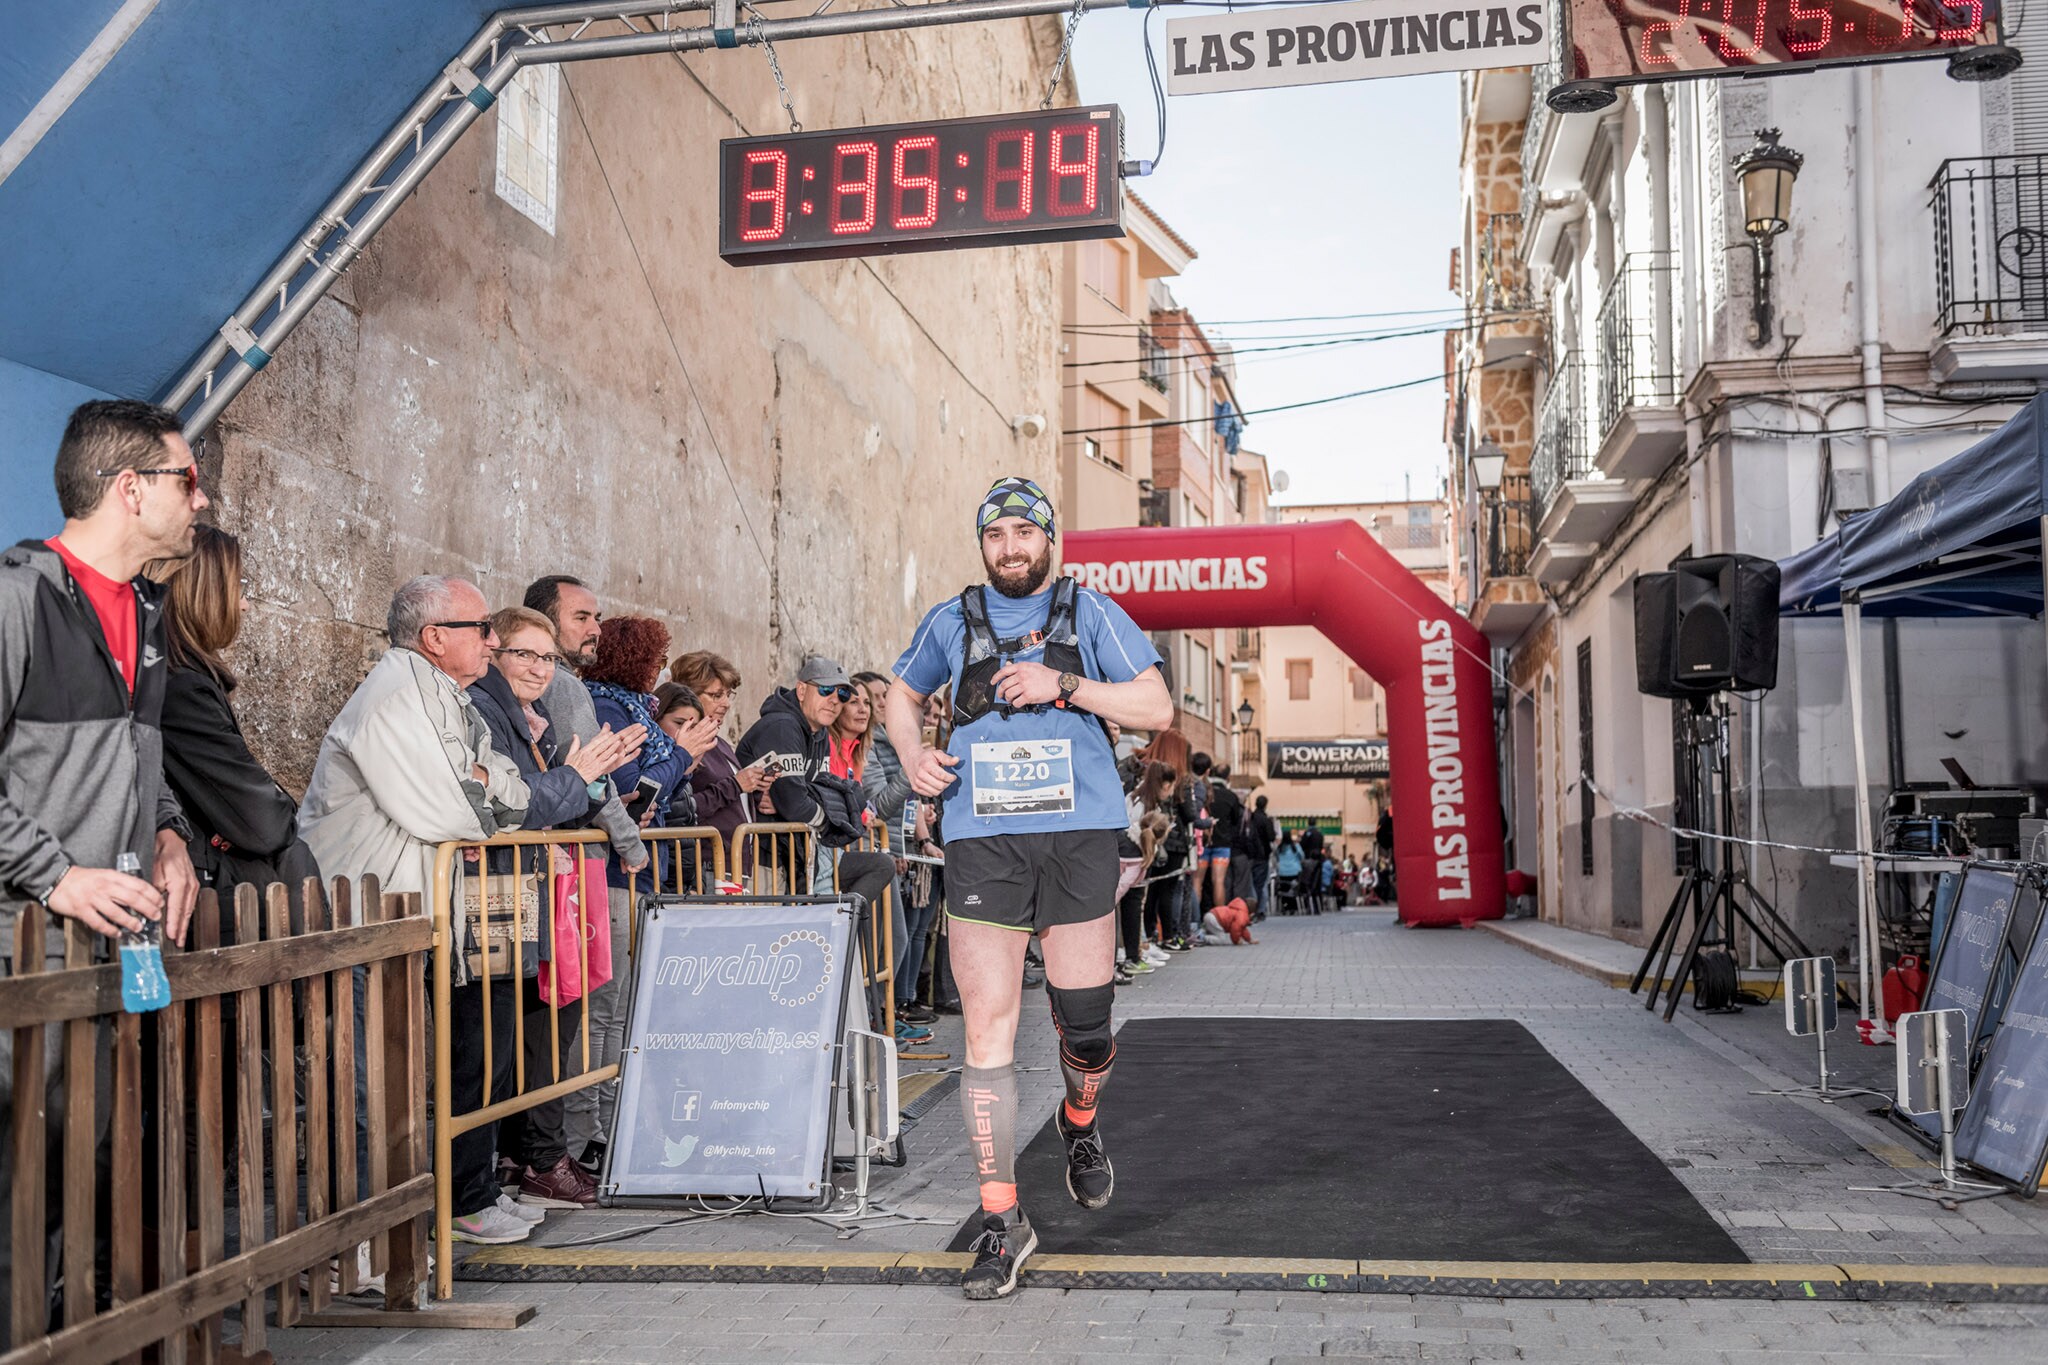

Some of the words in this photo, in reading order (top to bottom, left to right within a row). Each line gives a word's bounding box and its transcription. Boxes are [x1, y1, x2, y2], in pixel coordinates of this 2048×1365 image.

[1173, 31, 1255, 76] LAS
[1266, 4, 1542, 68] PROVINCIAS
[742, 126, 1099, 241] 3:35:14
[1063, 556, 1268, 594] PROVINCIAS
[1418, 619, 1467, 830] PROVINCIAS
[1281, 745, 1389, 762] POWERADE
[1281, 762, 1316, 773] bebida
[1317, 764, 1340, 775] para
[994, 762, 1051, 782] 1220
[1433, 835, 1472, 901] LAS
[656, 944, 802, 995] mychip
[645, 1028, 820, 1055] www.mychip.es
[710, 1099, 770, 1113] /infomychip
[703, 1145, 776, 1158] @Mychip_Info
